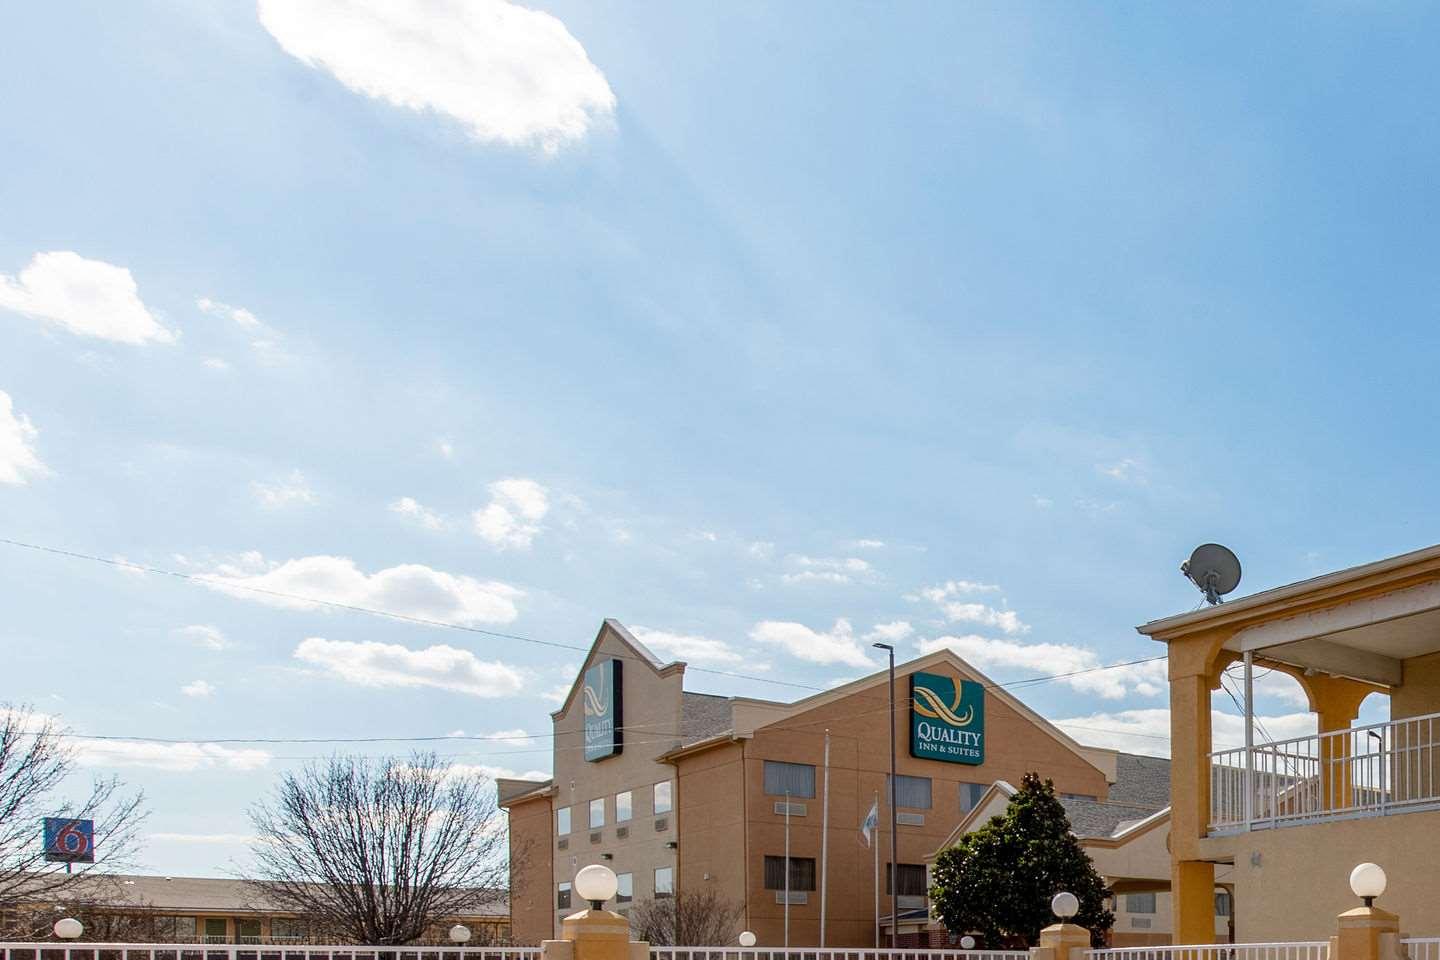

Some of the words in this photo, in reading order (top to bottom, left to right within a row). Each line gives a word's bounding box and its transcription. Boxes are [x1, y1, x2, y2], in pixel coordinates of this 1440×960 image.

[918, 722, 981, 746] QUALITY
[920, 742, 938, 752] INN
[940, 745, 946, 753] &
[948, 746, 980, 757] SUITES
[56, 820, 88, 857] 6
